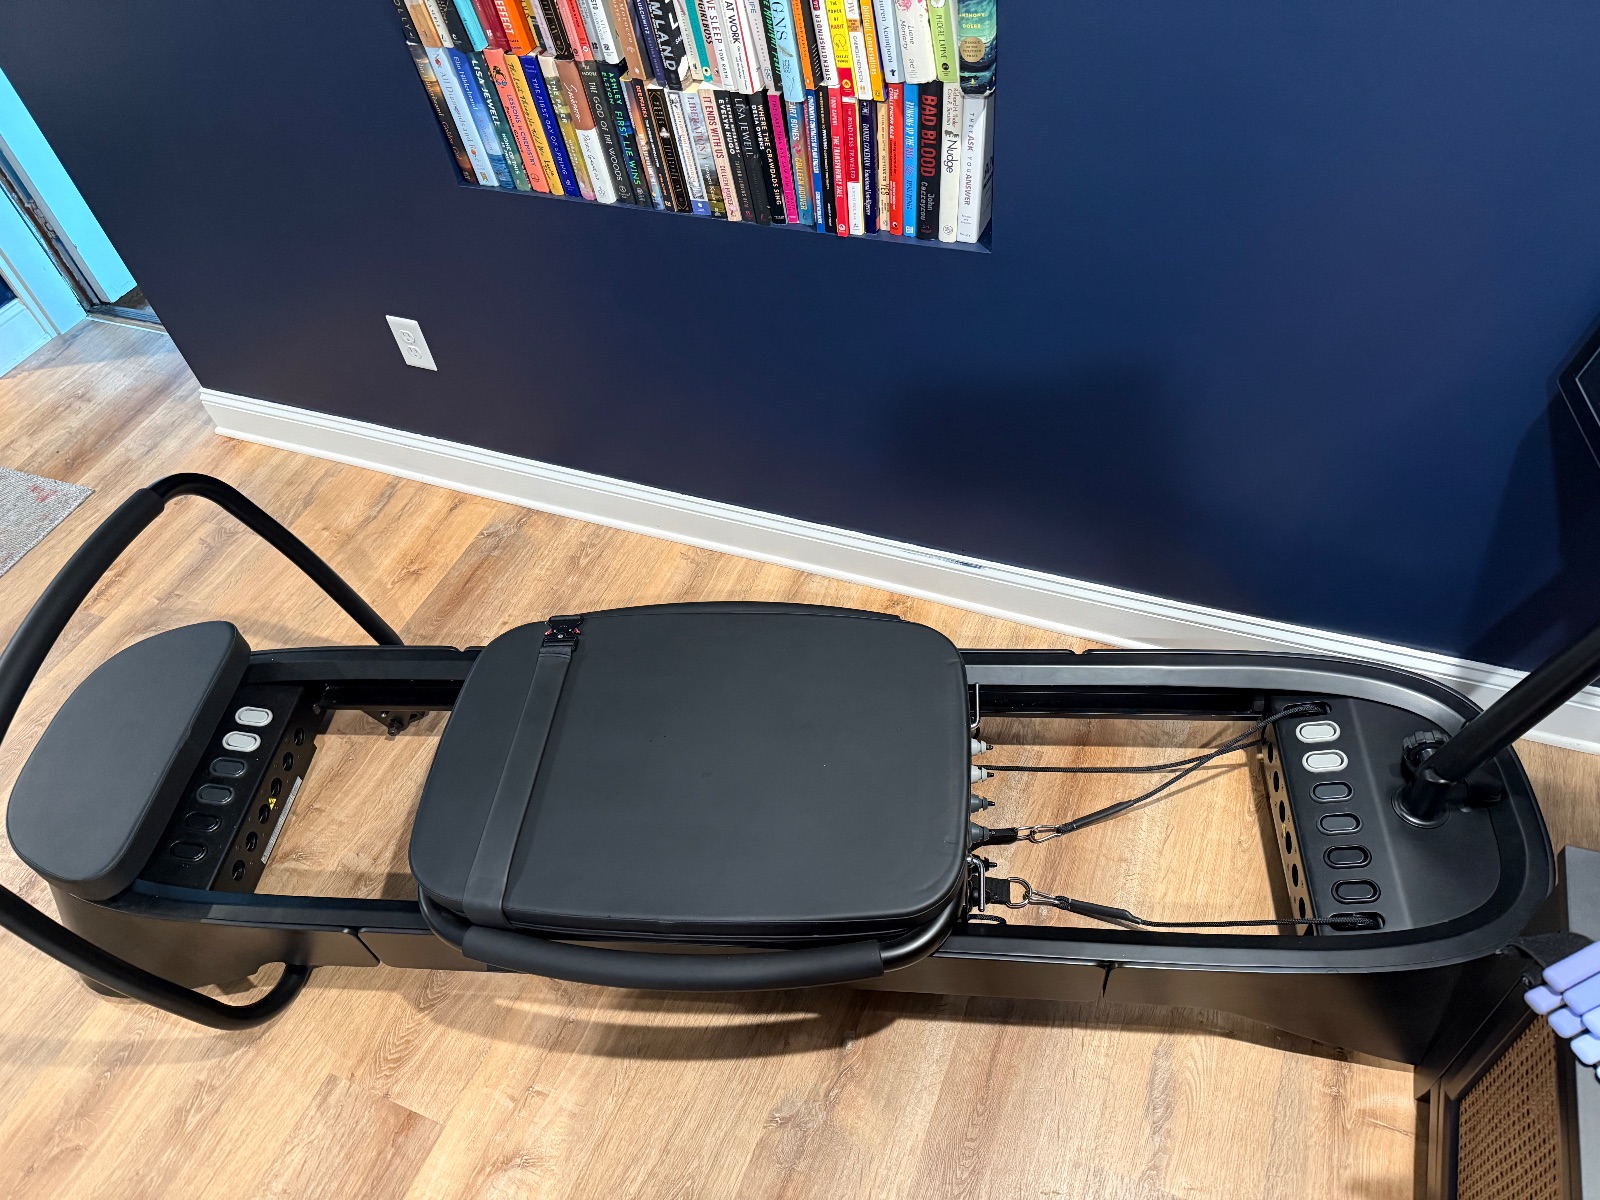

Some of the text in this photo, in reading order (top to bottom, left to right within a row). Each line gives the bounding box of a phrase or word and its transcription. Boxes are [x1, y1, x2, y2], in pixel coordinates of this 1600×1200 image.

[494, 0, 514, 34] EFFECT
[620, 4, 632, 43] Morocco
[725, 2, 734, 11] AT
[771, 2, 788, 41] GNS
[710, 16, 723, 44] SLEEP
[729, 15, 741, 44] WORK
[815, 15, 831, 81] STRENGTHSFINDER
[863, 6, 877, 75] Difficult Conversations
[440, 72, 450, 84] All
[453, 57, 478, 110] Elin Hilderbrand
[472, 61, 501, 127] LISA JEWELL
[602, 72, 614, 104] ELSTON
[608, 73, 622, 105] ASHLEY
[550, 81, 567, 123] THE PAPER
[705, 106, 717, 126] ENDS
[507, 95, 537, 166] LESSONS CHEMISTRY
[532, 79, 568, 175] THE FIRST DAY OF SPRING
[588, 83, 623, 181] THE GOD OF THE WOODS
[687, 97, 706, 152] LIBERATION
[710, 128, 722, 148] WITH
[719, 100, 735, 154] EVELYN HUGO
[735, 98, 754, 158] LISA JEWELL
[921, 96, 938, 177] BAD BLOOD
[502, 134, 511, 150] NONE
[512, 161, 520, 175] THIS
[615, 111, 628, 138] FIRST
[623, 142, 633, 156] LIE
[629, 161, 641, 185] WINS
[715, 149, 724, 159] US
[758, 105, 767, 130] WHERE
[766, 149, 778, 188] CRAWDADS
[834, 146, 842, 185] TRANSPARENCY
[944, 140, 958, 174] Nudge
[720, 166, 730, 187] COLLEEN
[796, 158, 807, 210] COLLEEN HOOVER
[881, 184, 889, 196] YES
